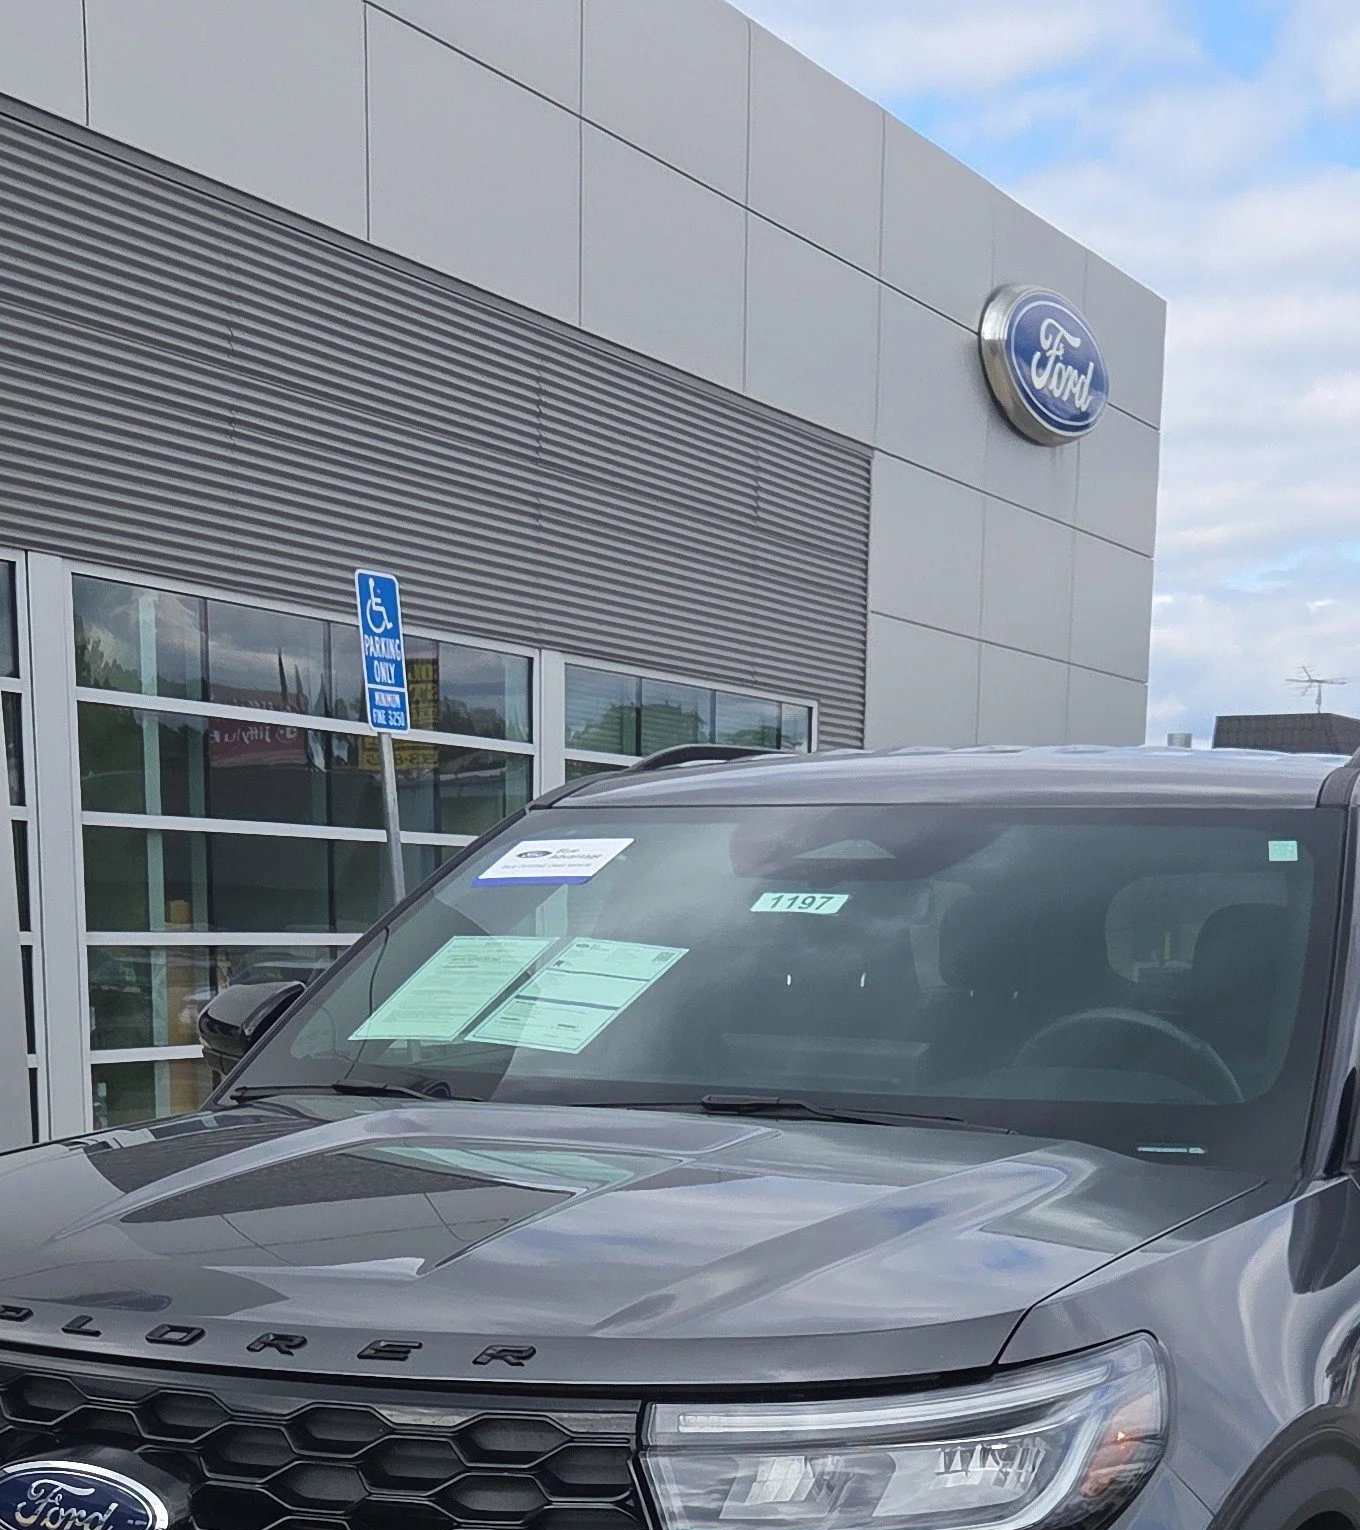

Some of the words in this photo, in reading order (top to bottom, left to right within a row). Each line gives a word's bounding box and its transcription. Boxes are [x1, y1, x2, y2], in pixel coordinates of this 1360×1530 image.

[1031, 318, 1095, 412] Ford
[364, 634, 401, 661] PARKING
[373, 660, 396, 684] ONLY
[770, 894, 835, 911] 1197
